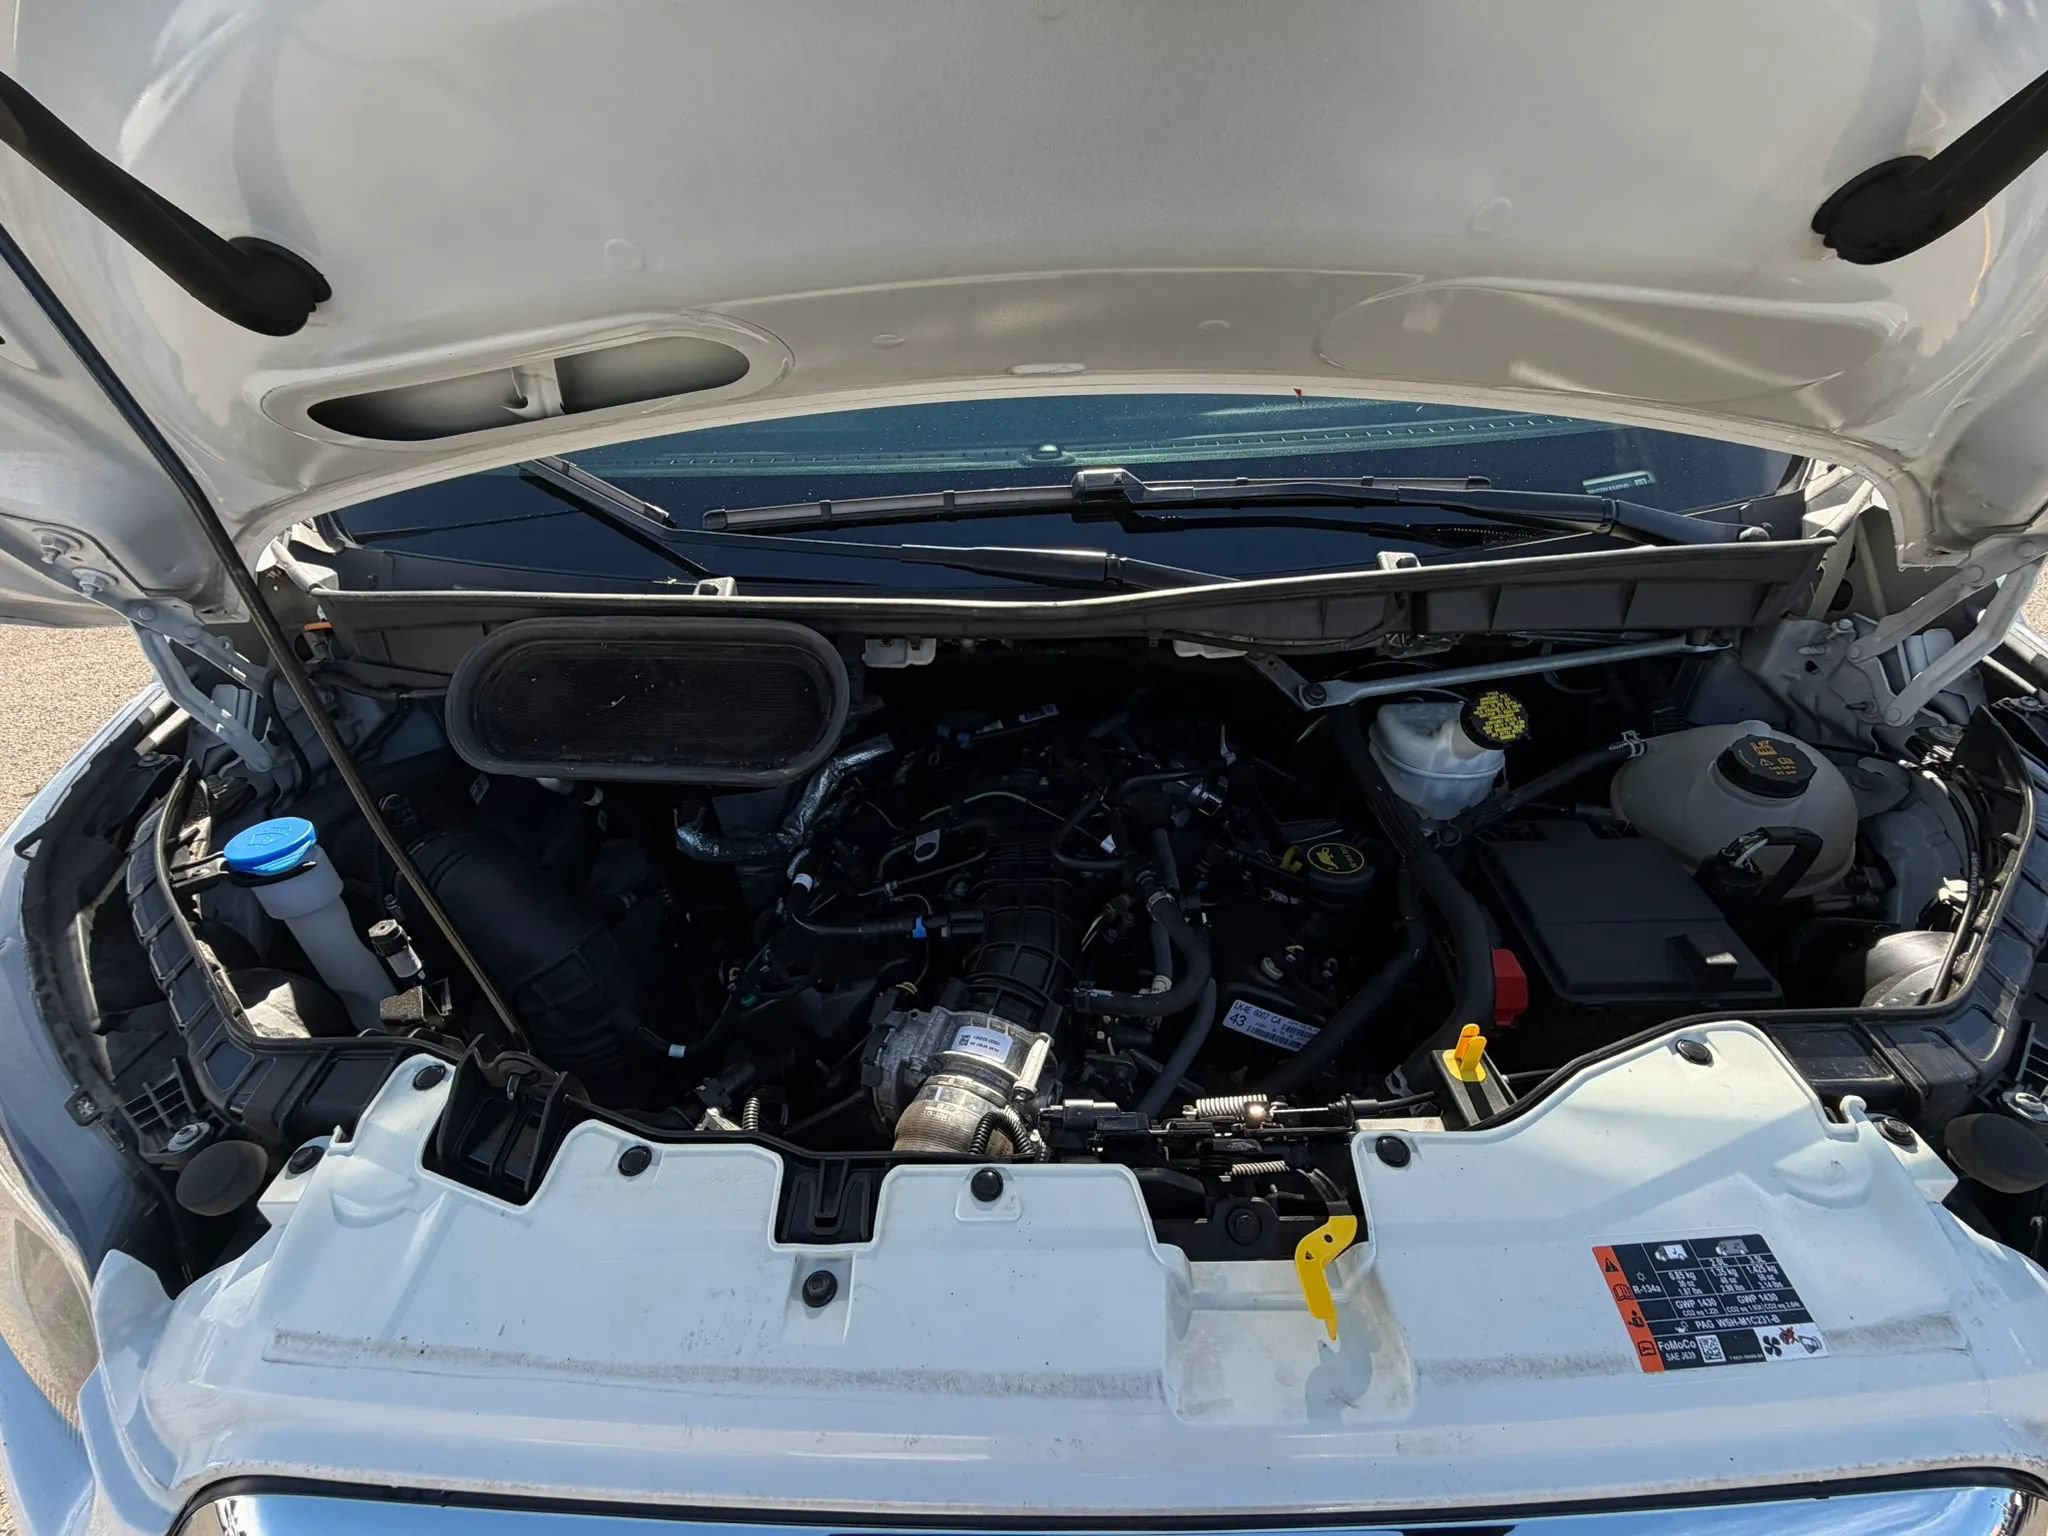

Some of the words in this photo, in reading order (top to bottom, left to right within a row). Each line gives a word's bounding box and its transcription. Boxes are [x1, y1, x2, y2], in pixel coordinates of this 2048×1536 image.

[1229, 1013, 1247, 1027] 43
[1727, 1266, 1739, 1277] kg
[1766, 1263, 1778, 1274] kg
[1685, 1270, 1697, 1281] kg
[1632, 1284, 1662, 1294] R-134a
[1675, 1300, 1696, 1309] GWP
[1697, 1297, 1717, 1308] 1430
[1736, 1295, 1757, 1304] GWP
[1758, 1293, 1779, 1302] 1430
[1682, 1309, 1696, 1317] CO2
[1695, 1320, 1714, 1330] PAG
[1716, 1314, 1781, 1328] WSH-M1C231-B
[1657, 1339, 1696, 1351] FoMoCo
[1666, 1352, 1680, 1361] SAE
